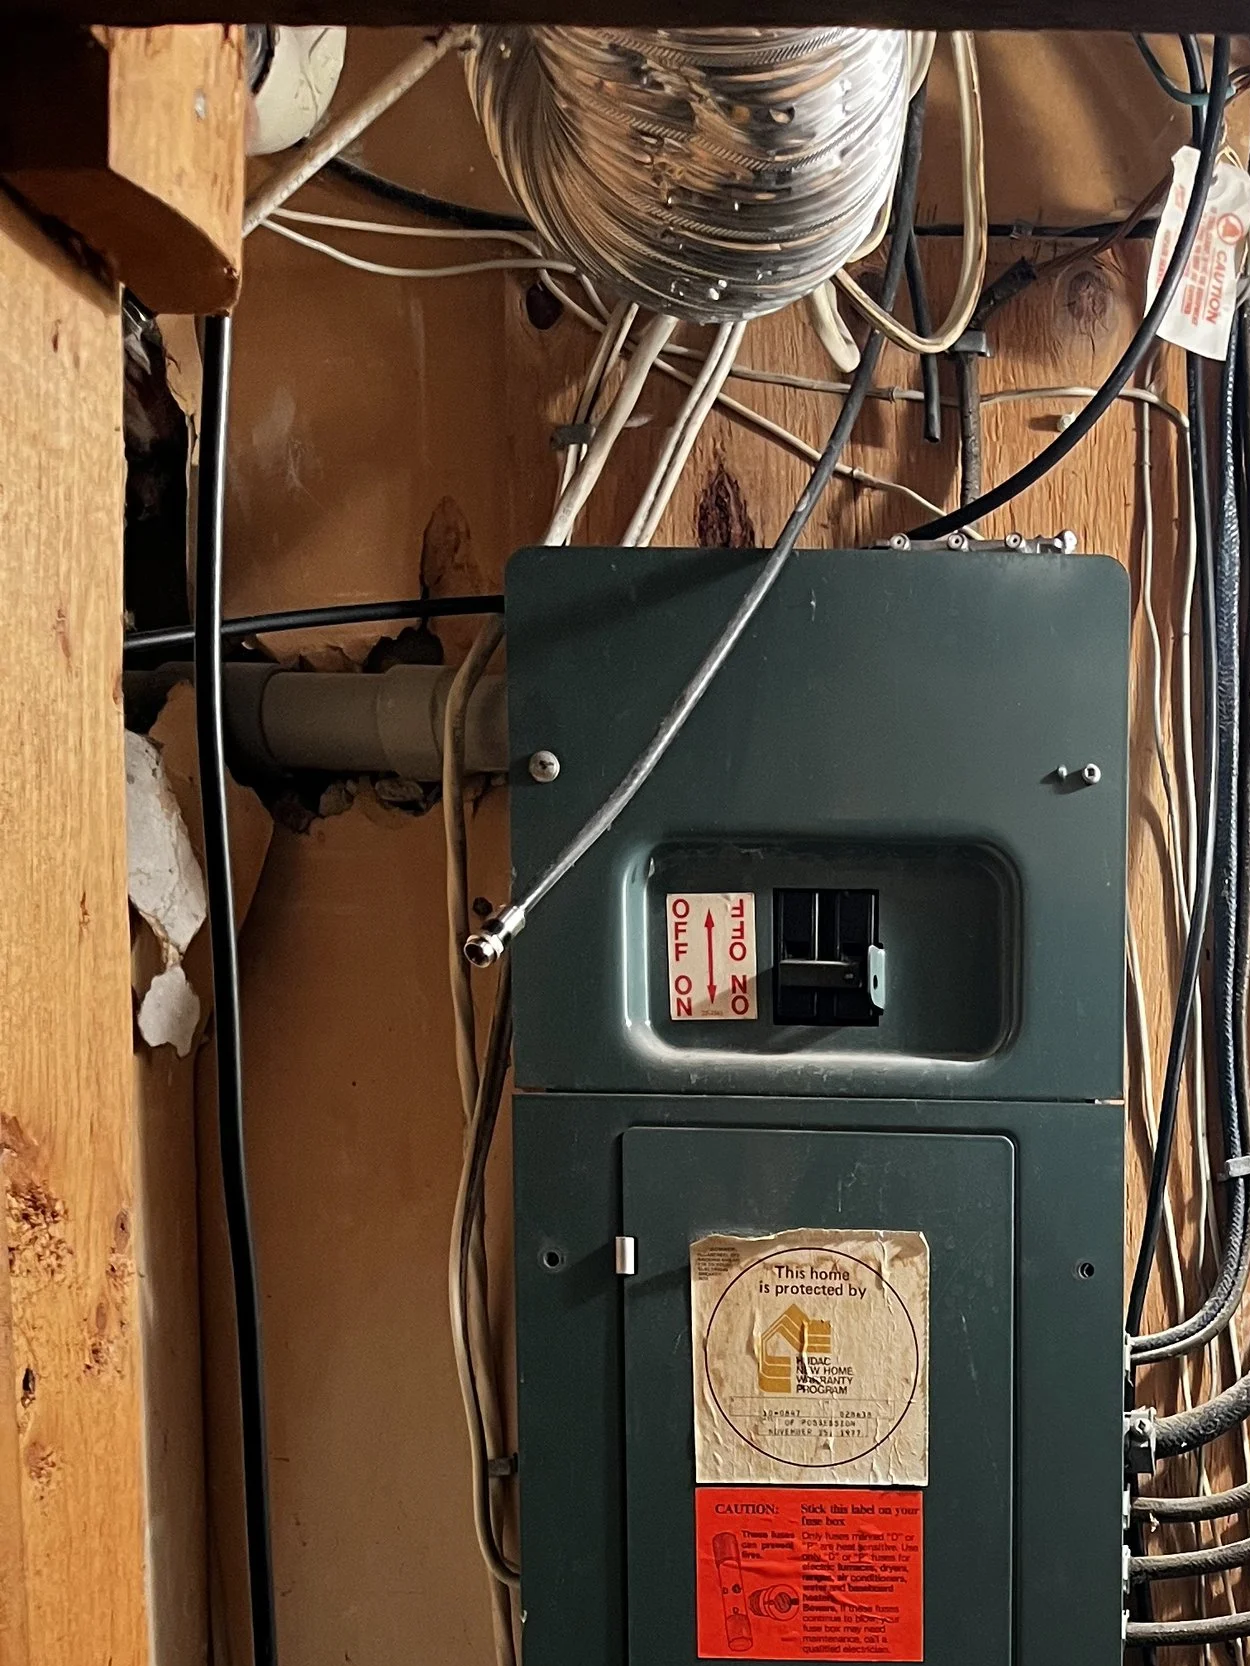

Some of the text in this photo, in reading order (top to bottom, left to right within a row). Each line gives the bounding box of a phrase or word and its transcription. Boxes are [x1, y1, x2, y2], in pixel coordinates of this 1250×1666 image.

[1206, 250, 1227, 325] CAUTION
[672, 899, 690, 962] OFF
[674, 975, 692, 1017] ON
[774, 1265, 850, 1281] This home
[759, 1280, 867, 1300] is protected by
[823, 1366, 854, 1376] HOME
[796, 1384, 849, 1395] PROGRAM
[801, 1419, 856, 1428] POSSESSION
[715, 1504, 779, 1515] CAUTION:
[801, 1503, 920, 1517] Stick this label on your
[801, 1515, 846, 1526] fuse box
[802, 1531, 822, 1542] Only
[825, 1532, 849, 1541] fuses
[901, 1544, 919, 1552] Use
[898, 1553, 911, 1561] for
[844, 1614, 852, 1623] to
[803, 1624, 886, 1635] fuse box may need
[802, 1635, 862, 1644] maintenance,
[864, 1634, 879, 1643] call
[802, 1645, 841, 1654] qualified
